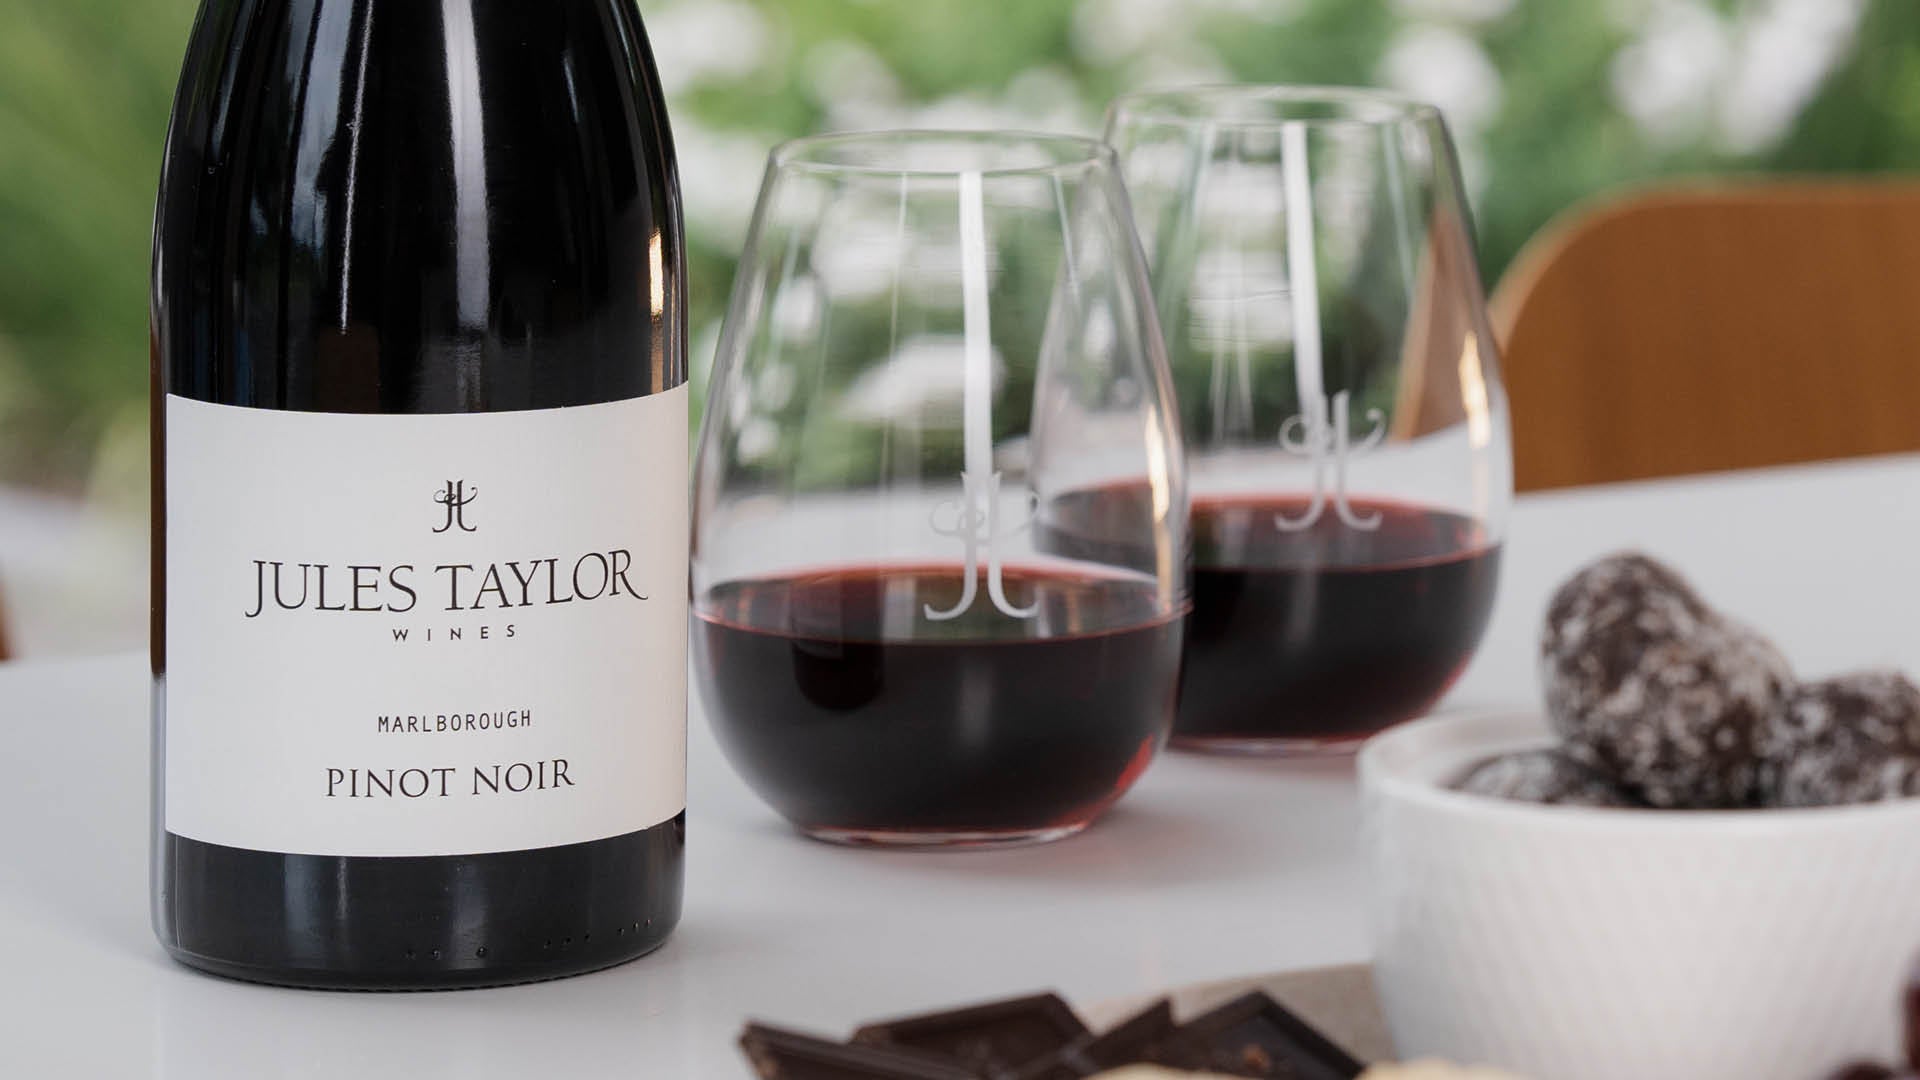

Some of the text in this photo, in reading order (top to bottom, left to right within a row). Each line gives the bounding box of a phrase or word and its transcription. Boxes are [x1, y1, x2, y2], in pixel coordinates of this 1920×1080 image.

[244, 549, 649, 618] JULES TAYLOR
[392, 624, 518, 642] WINES
[377, 709, 532, 733] MARLBOROUGH
[325, 758, 576, 798] PINOT NOIR
